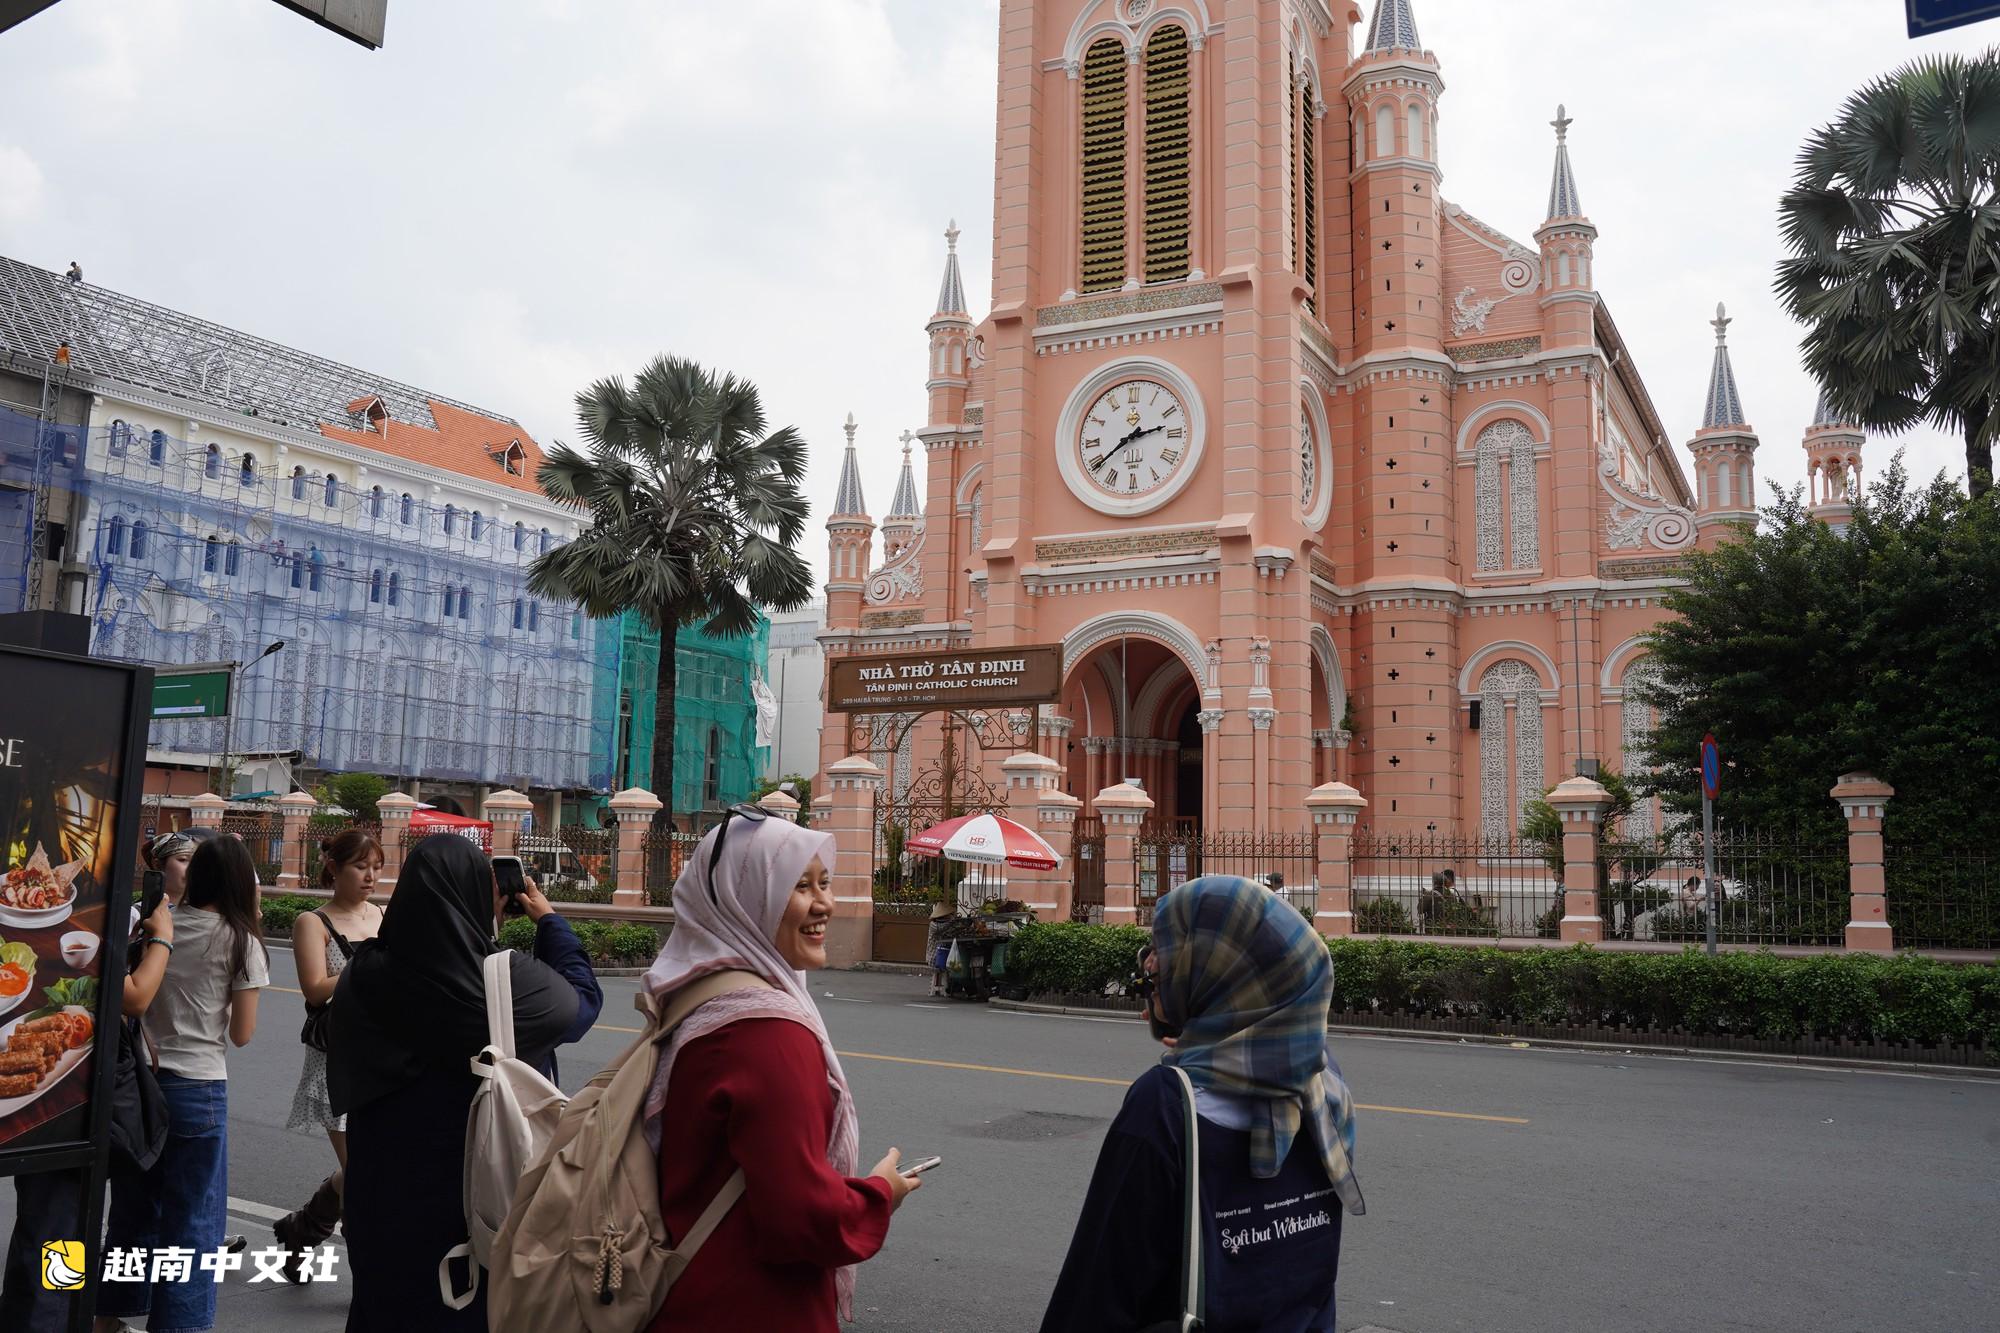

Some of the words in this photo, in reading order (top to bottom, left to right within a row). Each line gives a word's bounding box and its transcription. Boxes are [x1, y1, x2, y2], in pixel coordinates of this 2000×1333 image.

[859, 663, 896, 681] NHÀ
[899, 660, 935, 678] THỜ
[940, 660, 976, 676] TÂN
[980, 659, 1026, 676] ĐỊNH
[865, 682, 886, 693] TÂN
[887, 682, 913, 693] ĐỊNH
[915, 679, 968, 690] CATHOLIC
[971, 677, 1018, 687] CHURCH
[1221, 1228, 1251, 1249] Soft
[1251, 1227, 1272, 1244] but
